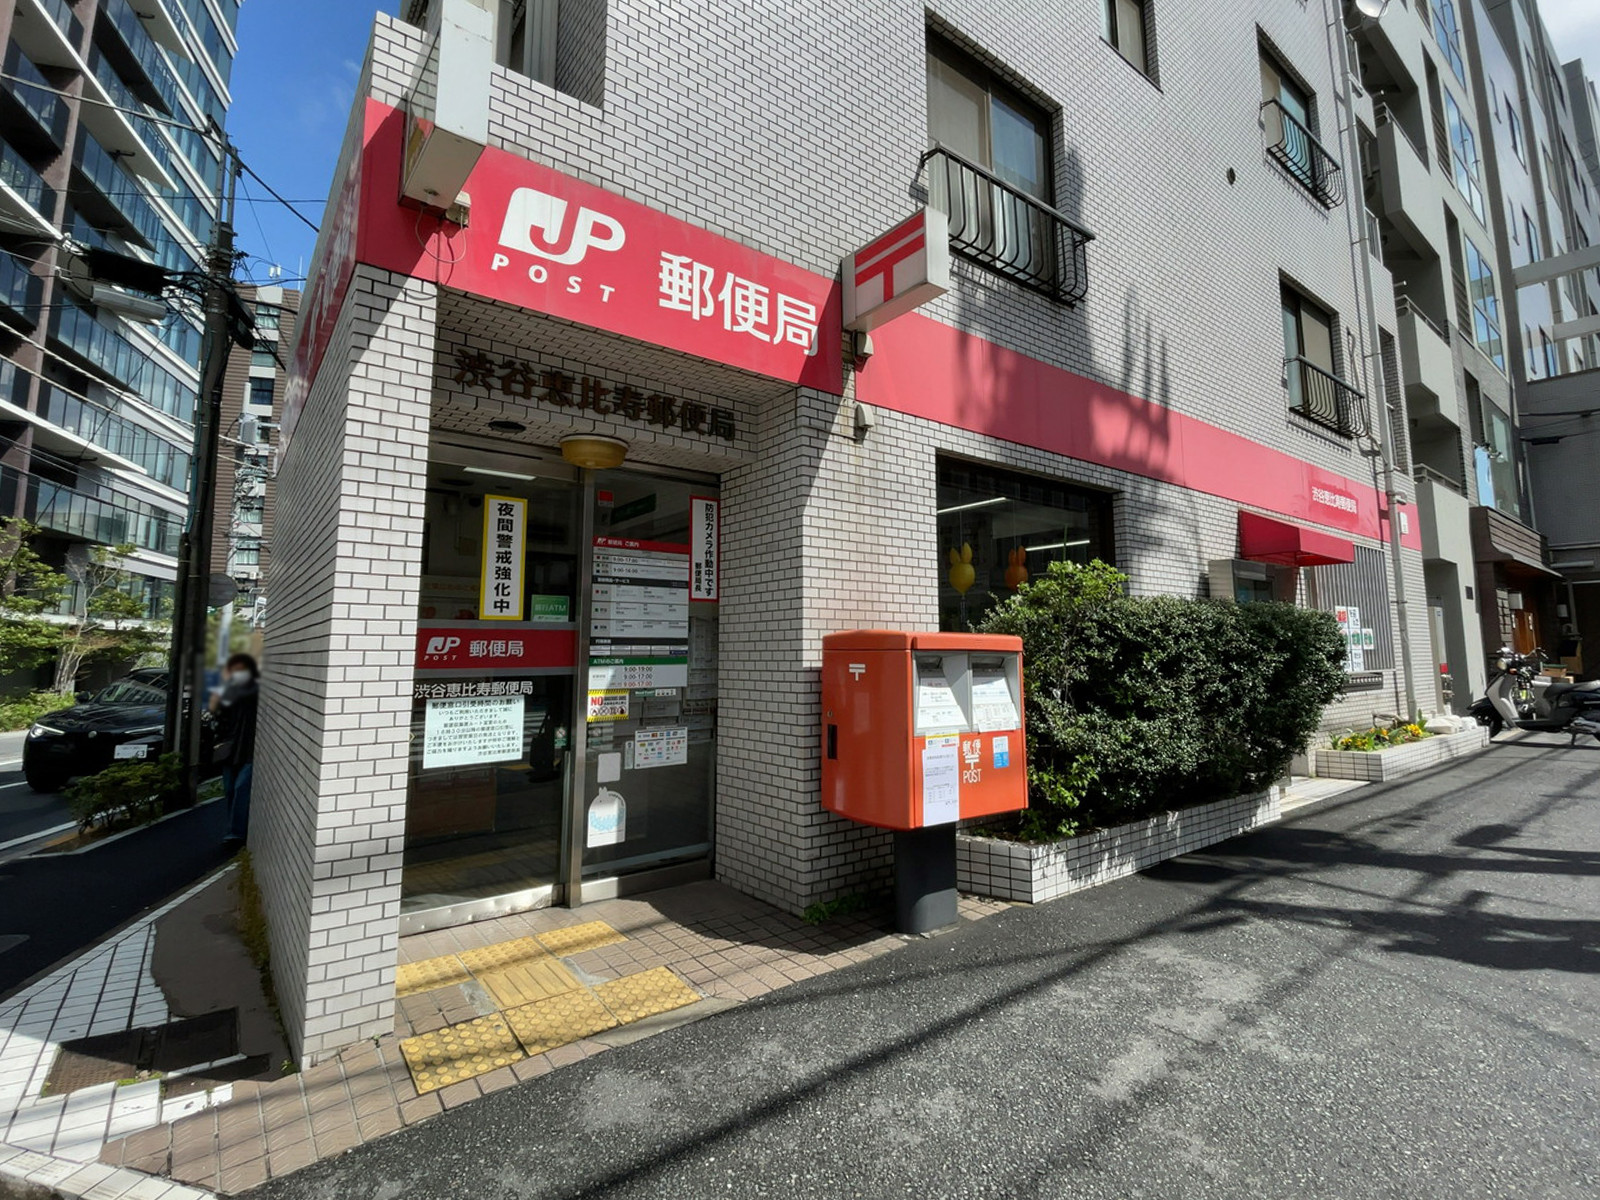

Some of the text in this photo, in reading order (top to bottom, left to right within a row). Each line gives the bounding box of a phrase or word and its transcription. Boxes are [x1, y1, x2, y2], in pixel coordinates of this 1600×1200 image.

[491, 253, 615, 302] POST
[498, 187, 818, 356] JP 郵便局
[454, 349, 736, 441] 渋谷恵比寿郵便局
[493, 503, 515, 613] 夜間警戒強化中
[705, 503, 714, 597] 防犯カメラ作動中です
[426, 637, 525, 658] JP 郵便局
[414, 681, 534, 699] 渋谷恵比寿郵便局
[590, 696, 604, 706] NO
[963, 739, 981, 756] 郵便
[963, 769, 981, 784] POST
